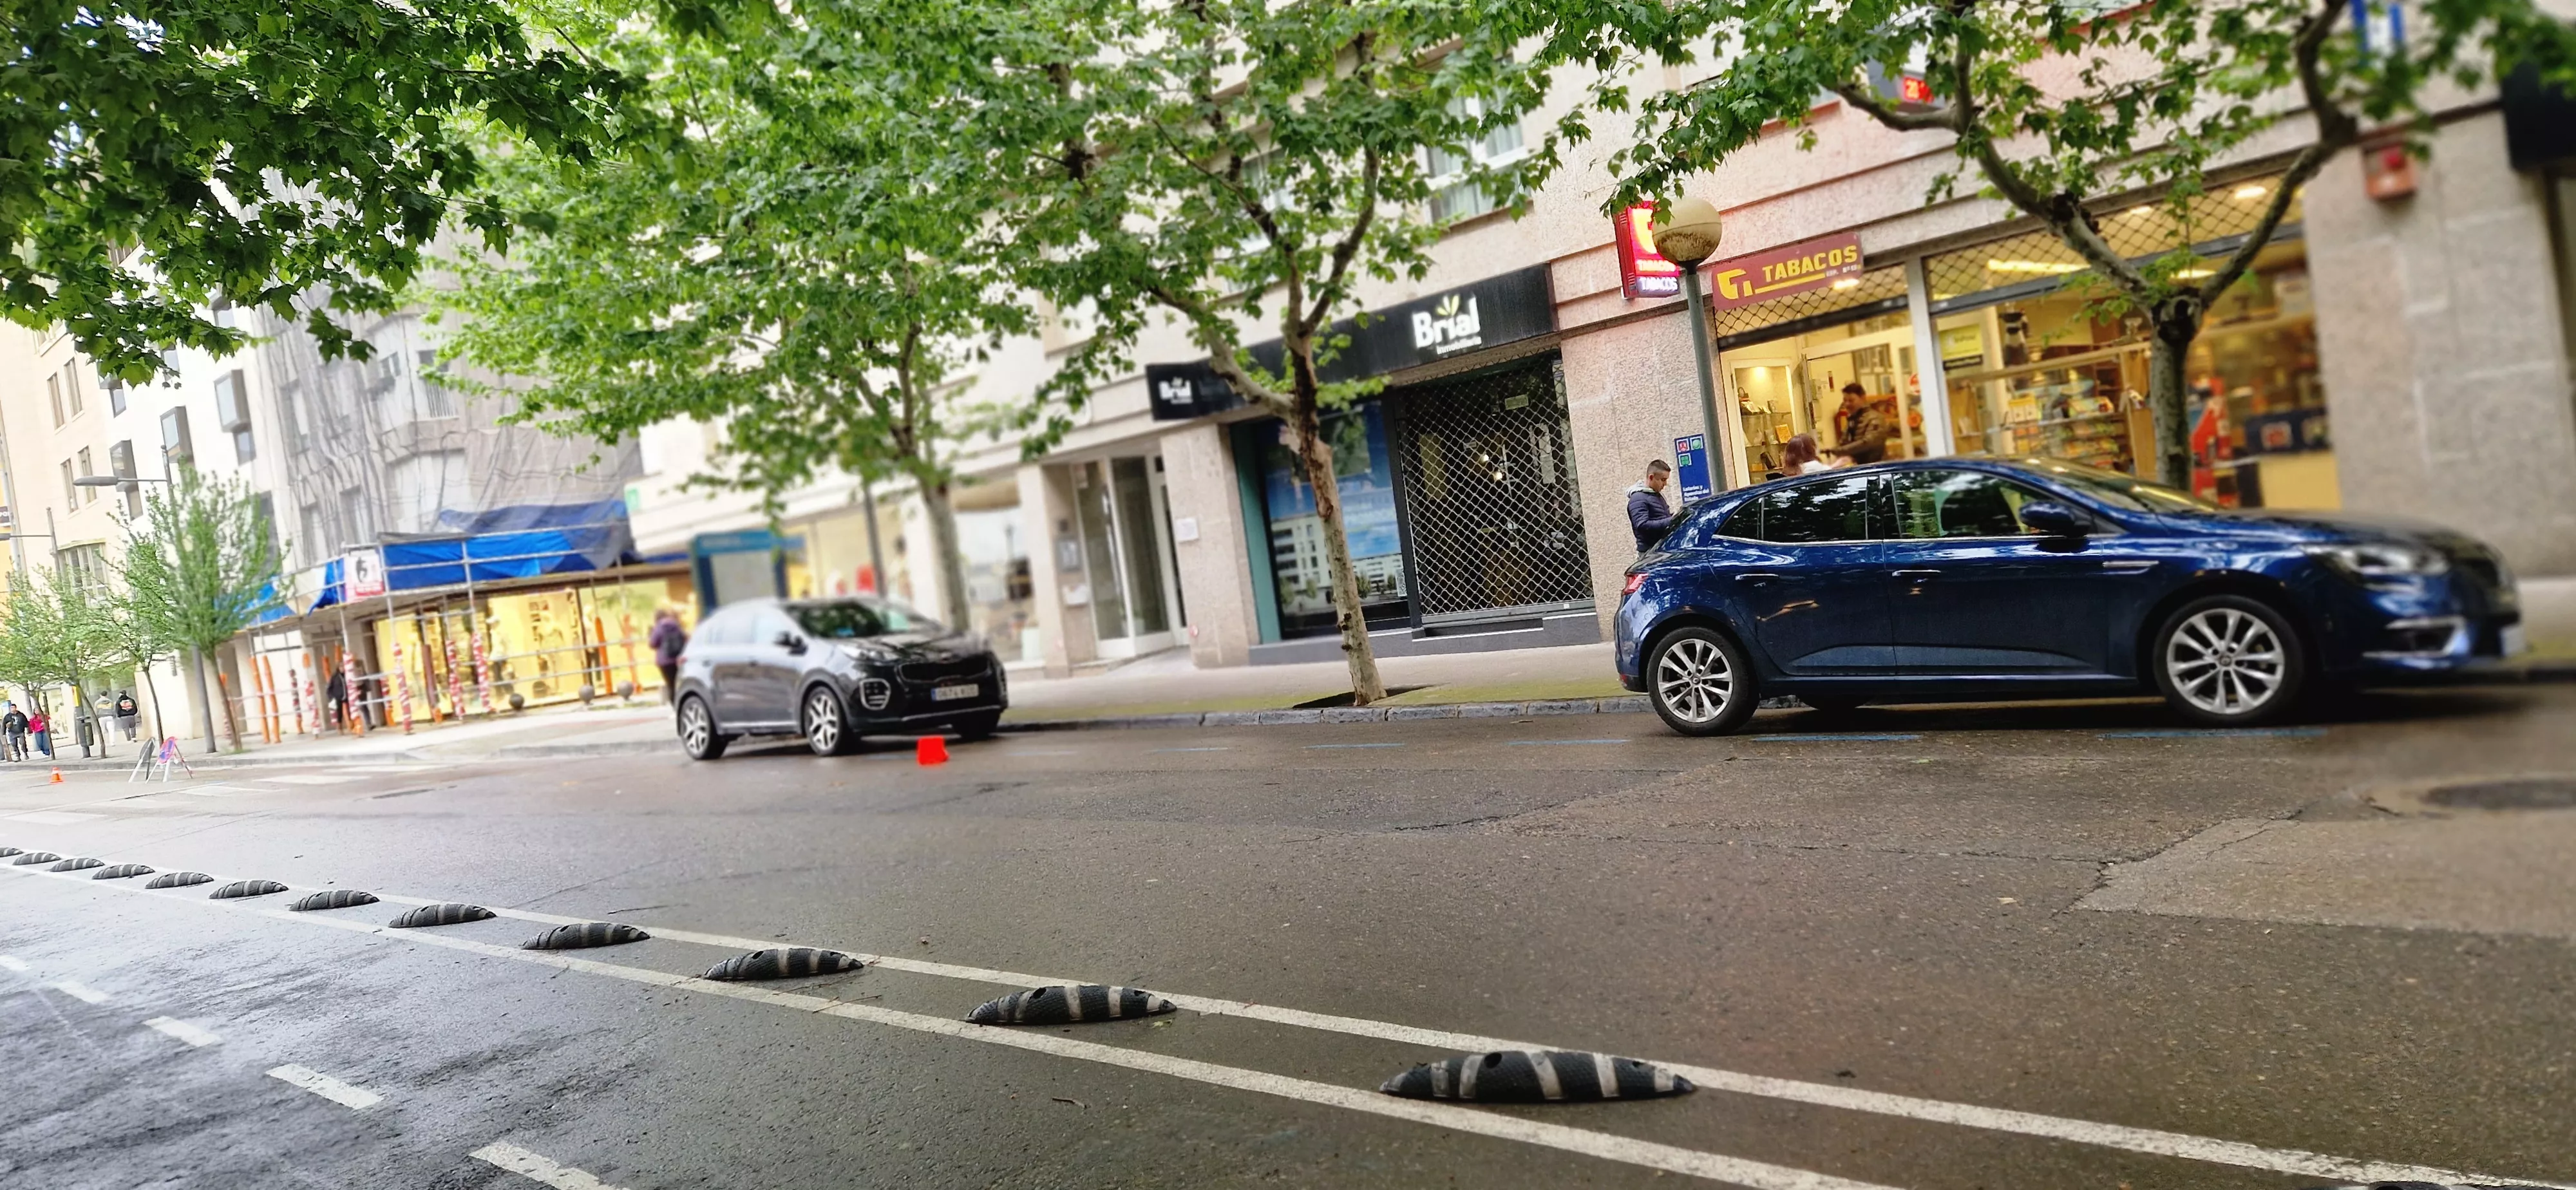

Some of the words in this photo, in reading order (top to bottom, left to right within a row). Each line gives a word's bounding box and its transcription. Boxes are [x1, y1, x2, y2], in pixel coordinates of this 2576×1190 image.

[1763, 245, 1857, 282] TABACOS
[1640, 276, 1678, 290] TABACOS
[1412, 296, 1481, 348] Brial
